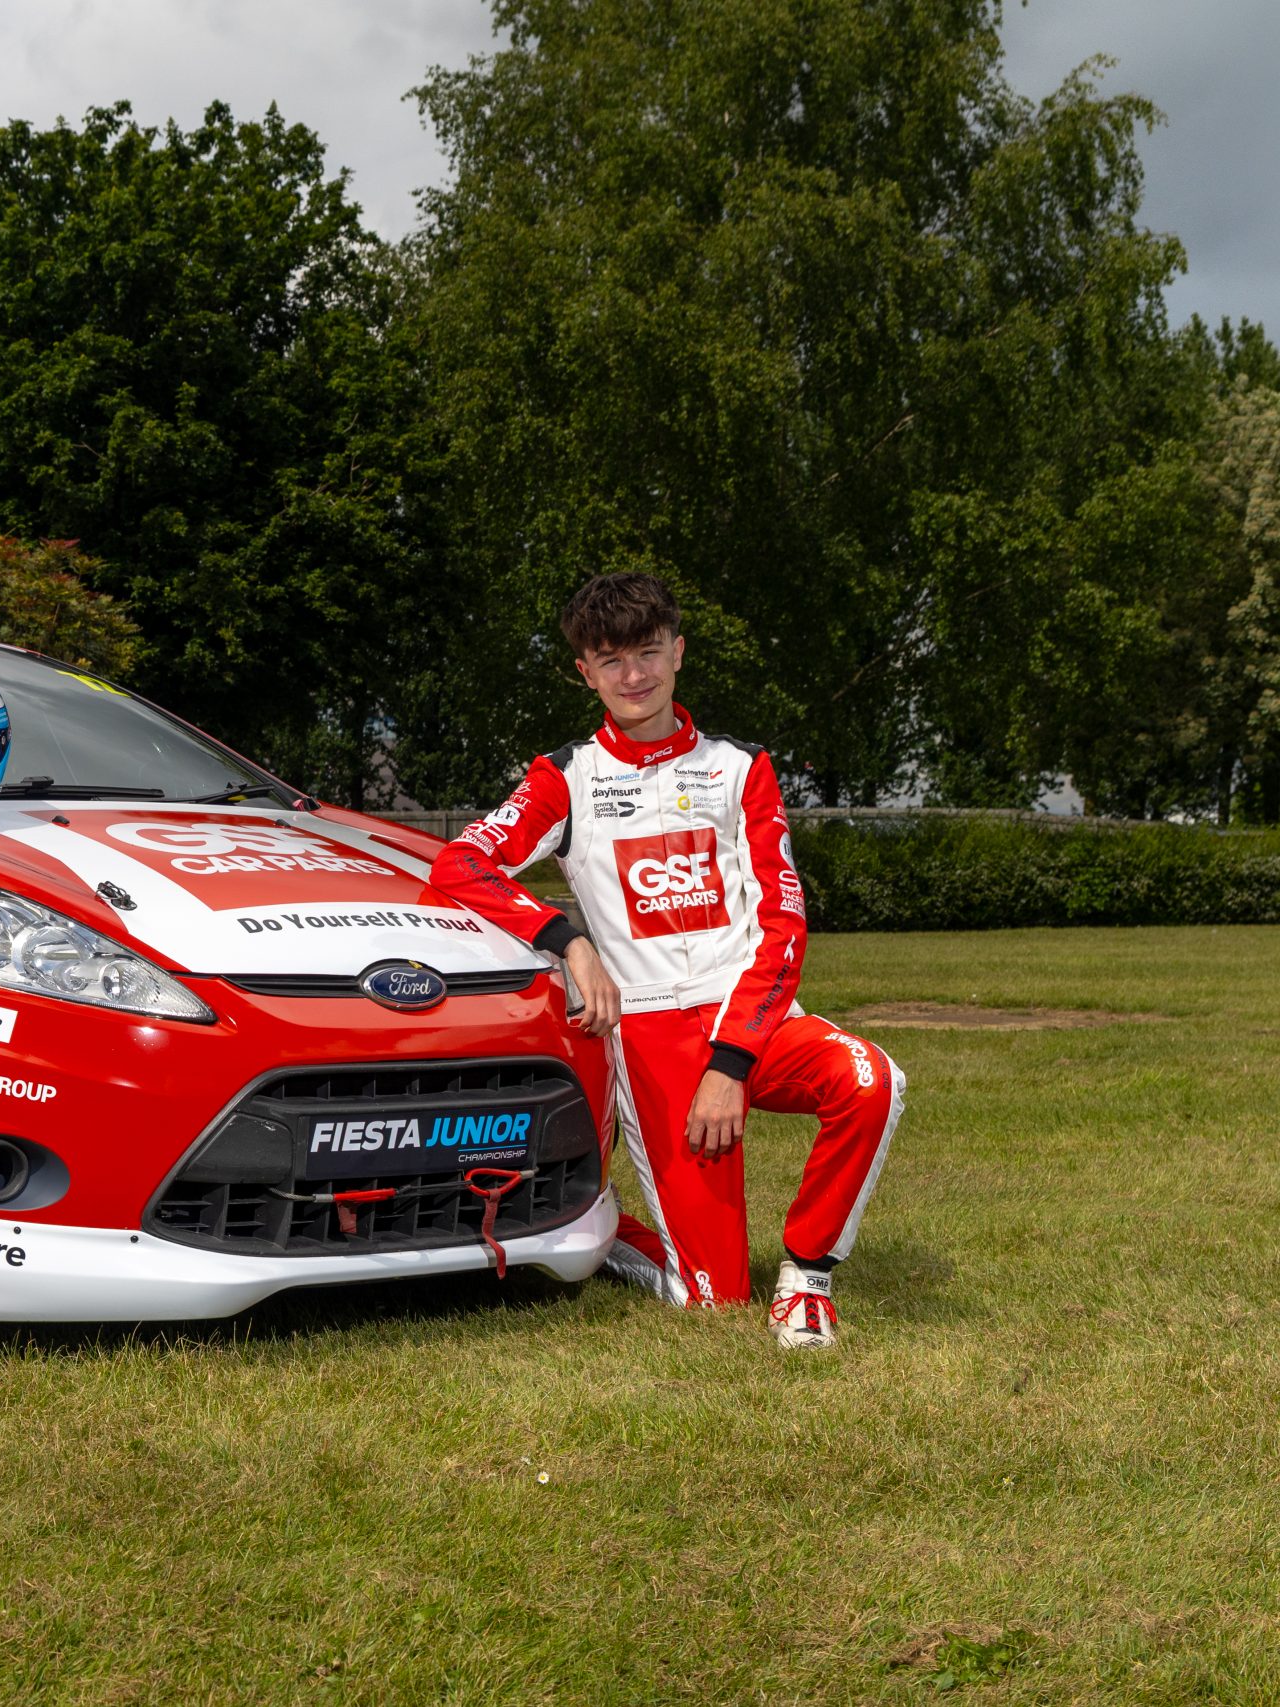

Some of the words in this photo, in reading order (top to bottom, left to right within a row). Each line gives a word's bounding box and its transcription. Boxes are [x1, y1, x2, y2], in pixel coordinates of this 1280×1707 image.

[614, 772, 641, 781] JUNIOR
[673, 768, 709, 777] Turkington
[591, 786, 642, 799] dayinsure
[105, 822, 339, 857] GSF
[170, 855, 271, 875] CAR
[270, 855, 397, 876] PARTS
[628, 851, 711, 897] GSF
[635, 896, 672, 915] CAR
[671, 889, 719, 909] PARTS
[236, 917, 283, 934] Do
[281, 911, 403, 929] Yourself
[402, 911, 484, 934] Proud
[388, 971, 433, 996] Ford
[623, 994, 675, 1004] TURKINGTON
[310, 1118, 421, 1153] FIESTA
[425, 1113, 532, 1148] JUNIOR
[457, 1149, 527, 1163] CHAMPIONSHIP
[806, 1278, 829, 1290] OMP
